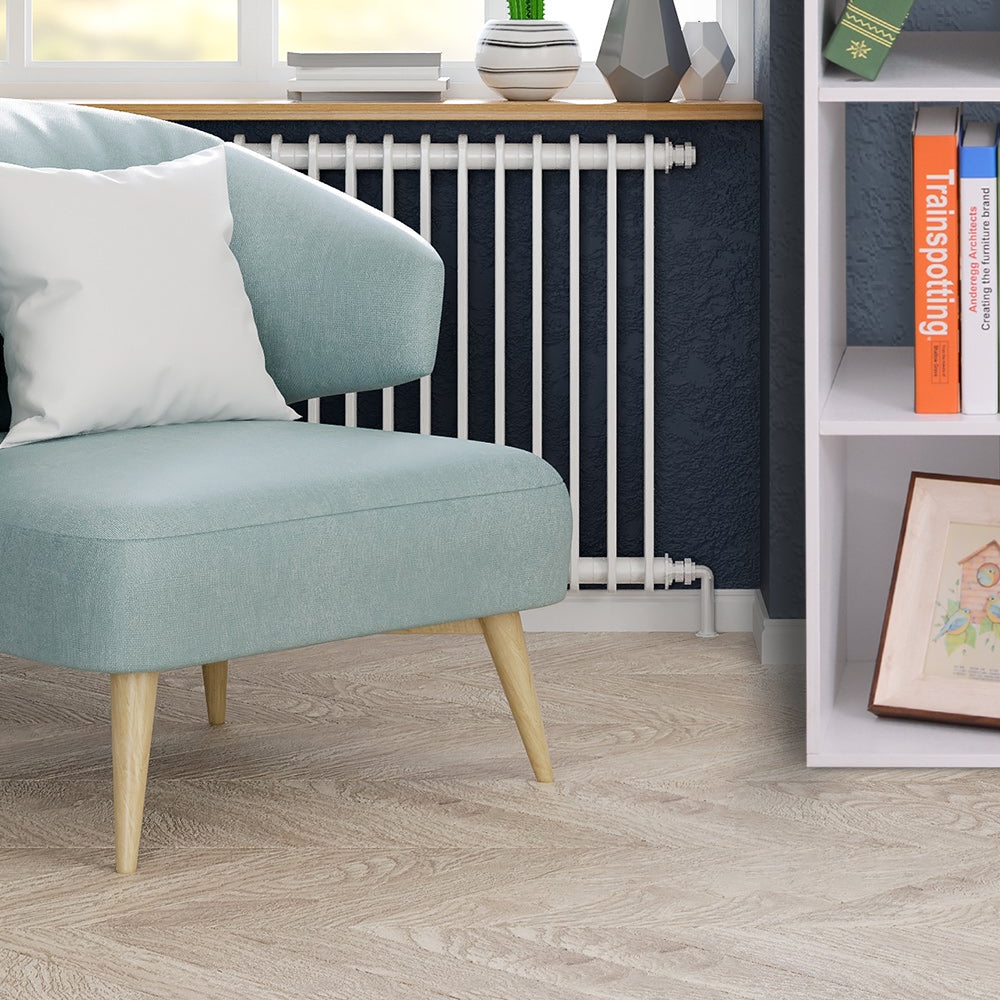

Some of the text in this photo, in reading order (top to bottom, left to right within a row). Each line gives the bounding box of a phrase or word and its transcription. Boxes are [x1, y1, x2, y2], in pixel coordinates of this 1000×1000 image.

[919, 169, 955, 336] Trainspotting
[968, 206, 979, 313] Anderegg Architects
[981, 187, 992, 331] Creating the furniture brand
